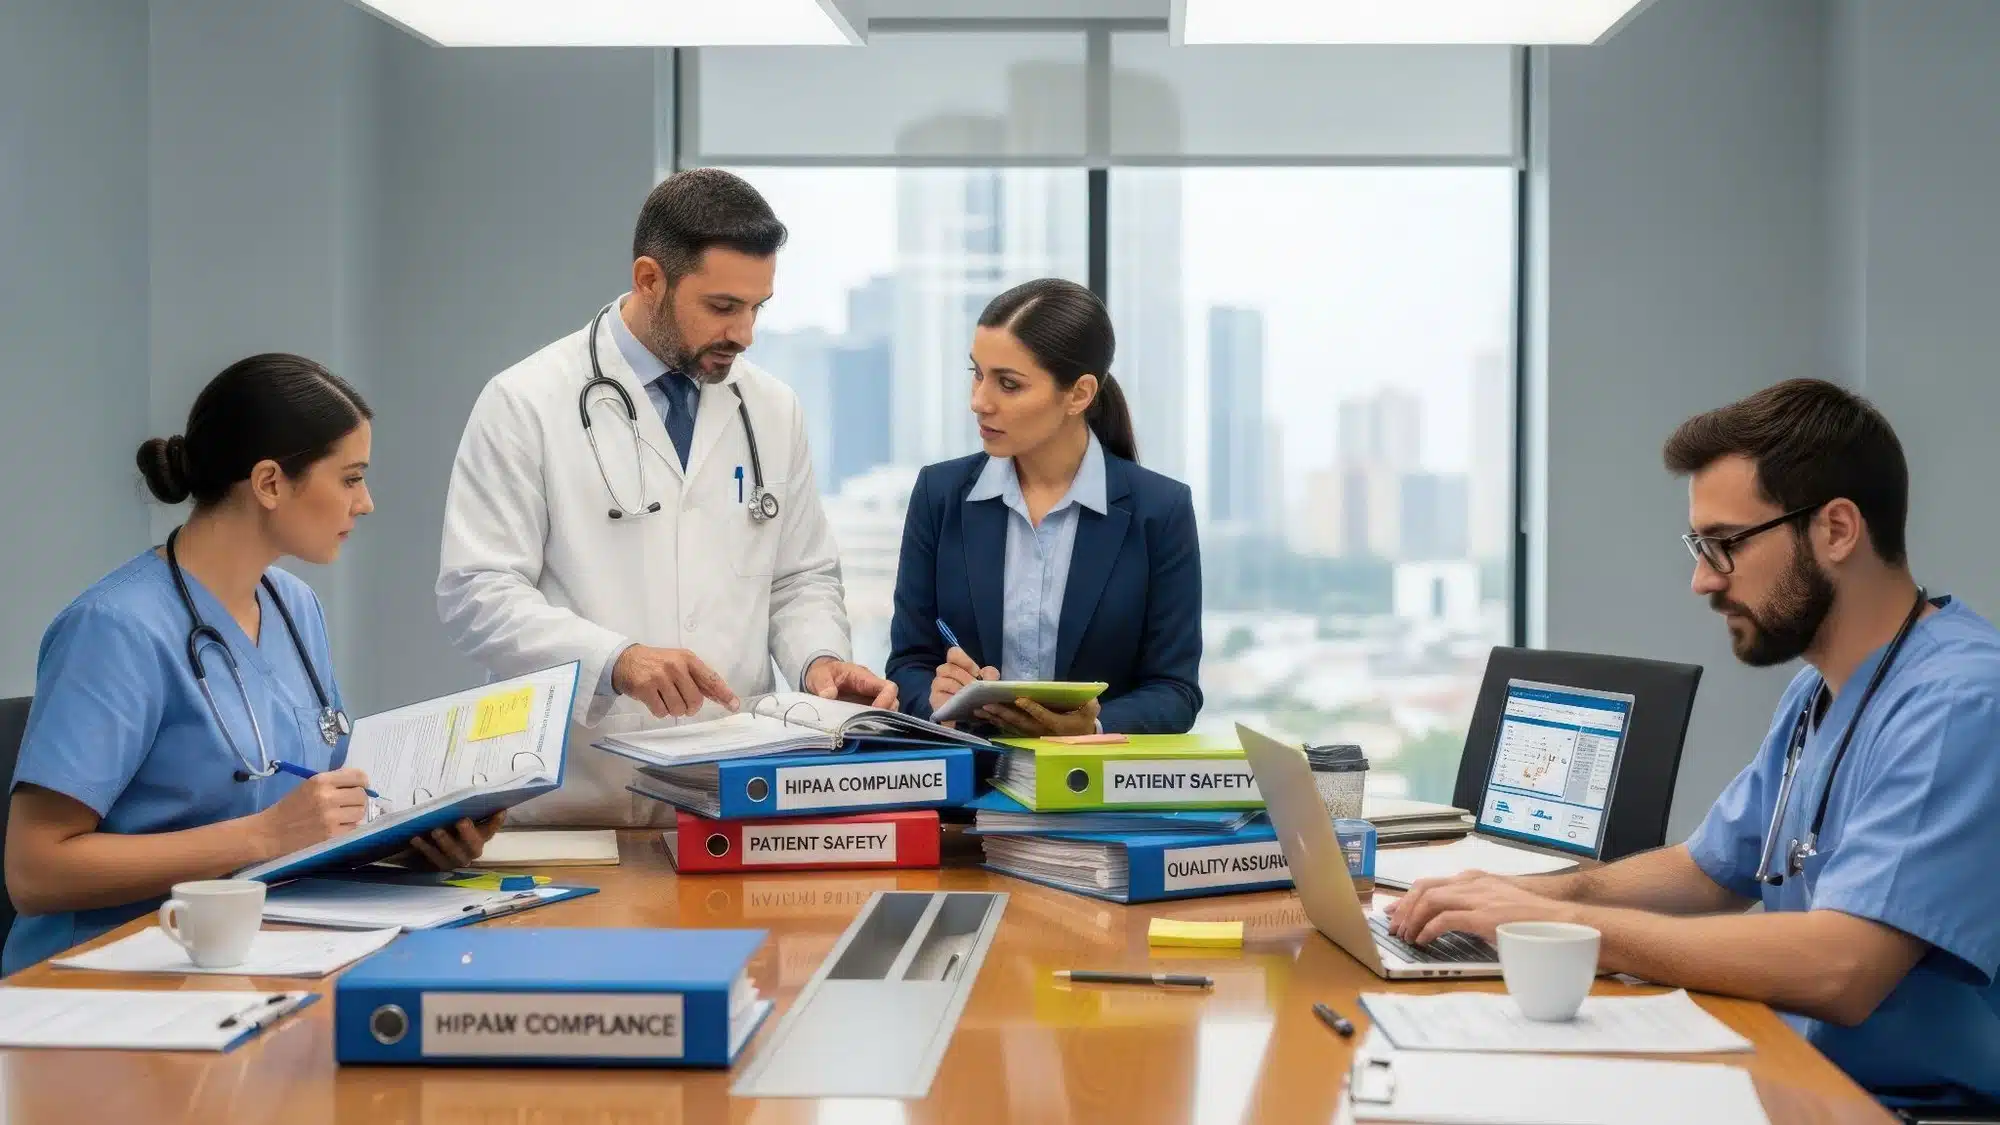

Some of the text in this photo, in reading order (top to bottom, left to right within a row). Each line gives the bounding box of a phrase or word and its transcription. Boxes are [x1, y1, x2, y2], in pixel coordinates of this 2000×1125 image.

[785, 778, 835, 795] HIPAA
[1114, 773, 1255, 789] PATIENT SAFETY
[750, 834, 888, 852] PATIENT SAFETY
[1167, 858, 1230, 878] QUALITY
